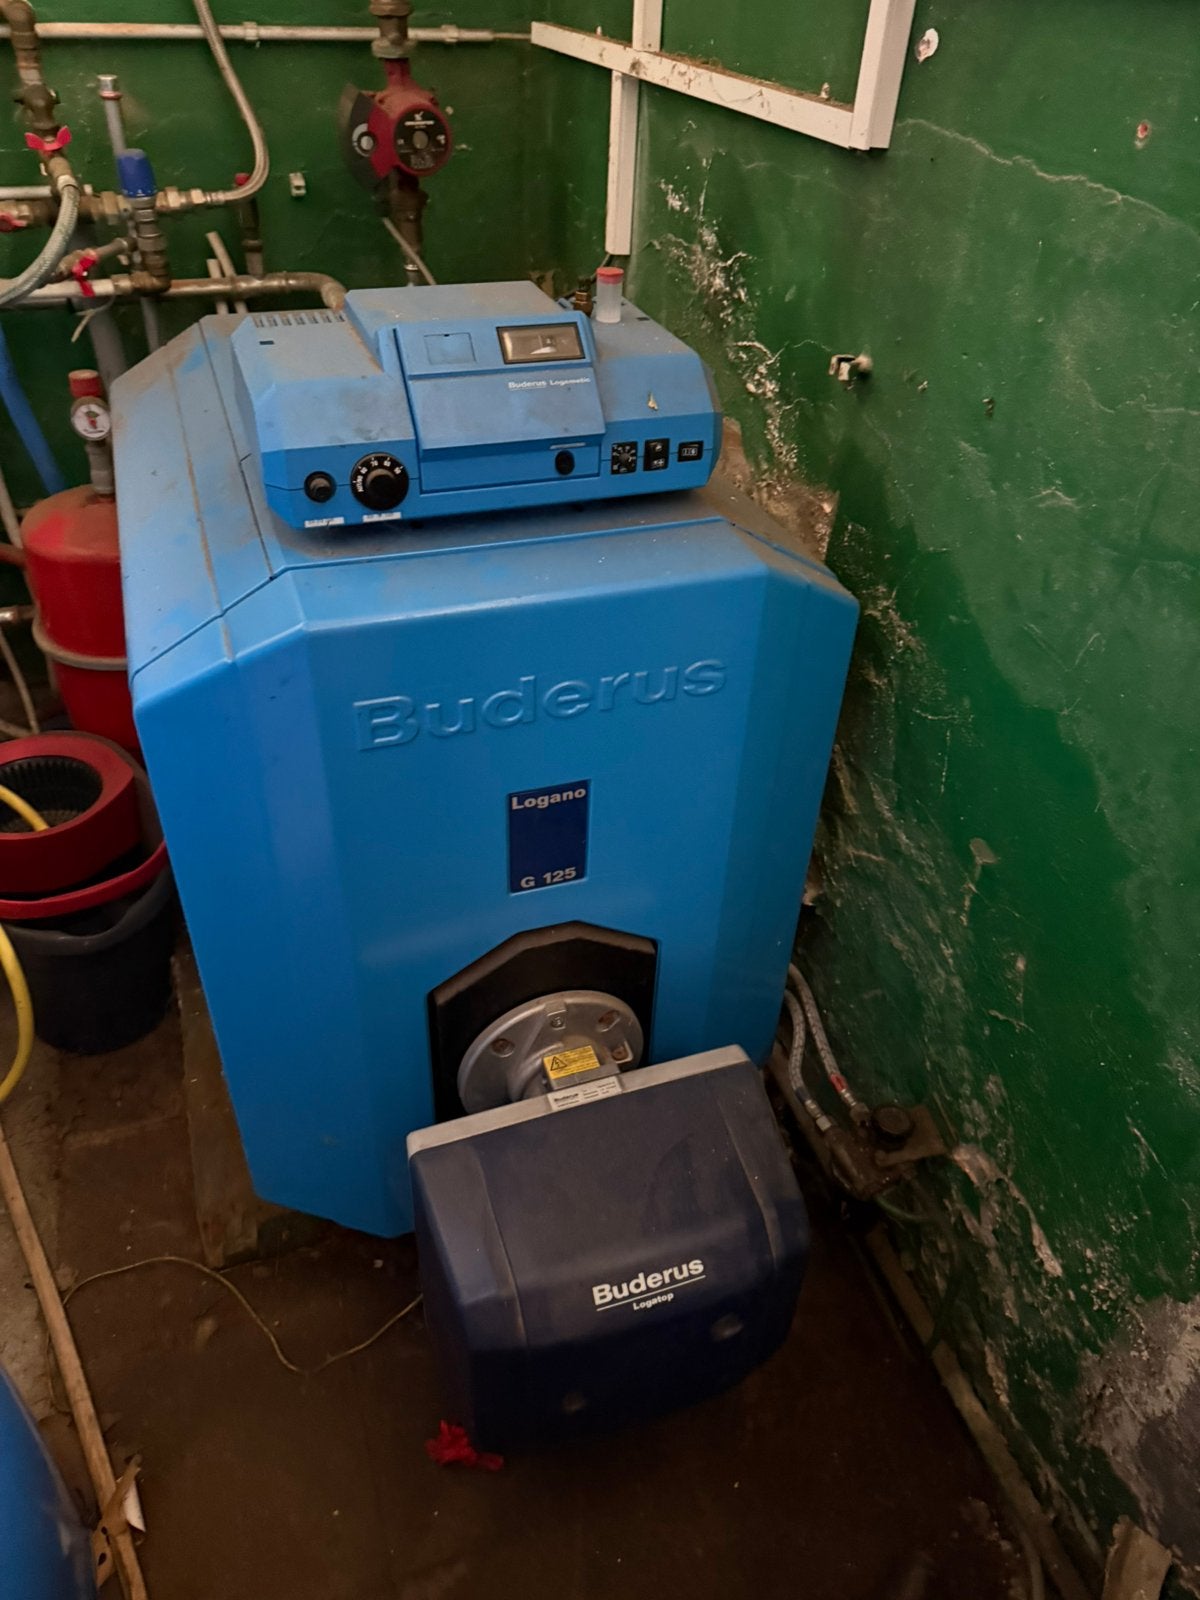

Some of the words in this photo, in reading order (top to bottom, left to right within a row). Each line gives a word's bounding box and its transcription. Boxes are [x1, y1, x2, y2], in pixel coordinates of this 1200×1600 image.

[508, 381, 547, 390] Buderus
[352, 659, 727, 750] Buderus
[511, 788, 587, 810] Logano
[520, 876, 536, 888] G
[543, 867, 577, 884] 125
[592, 1259, 704, 1306] Buderus
[632, 1292, 674, 1311] Logatop
